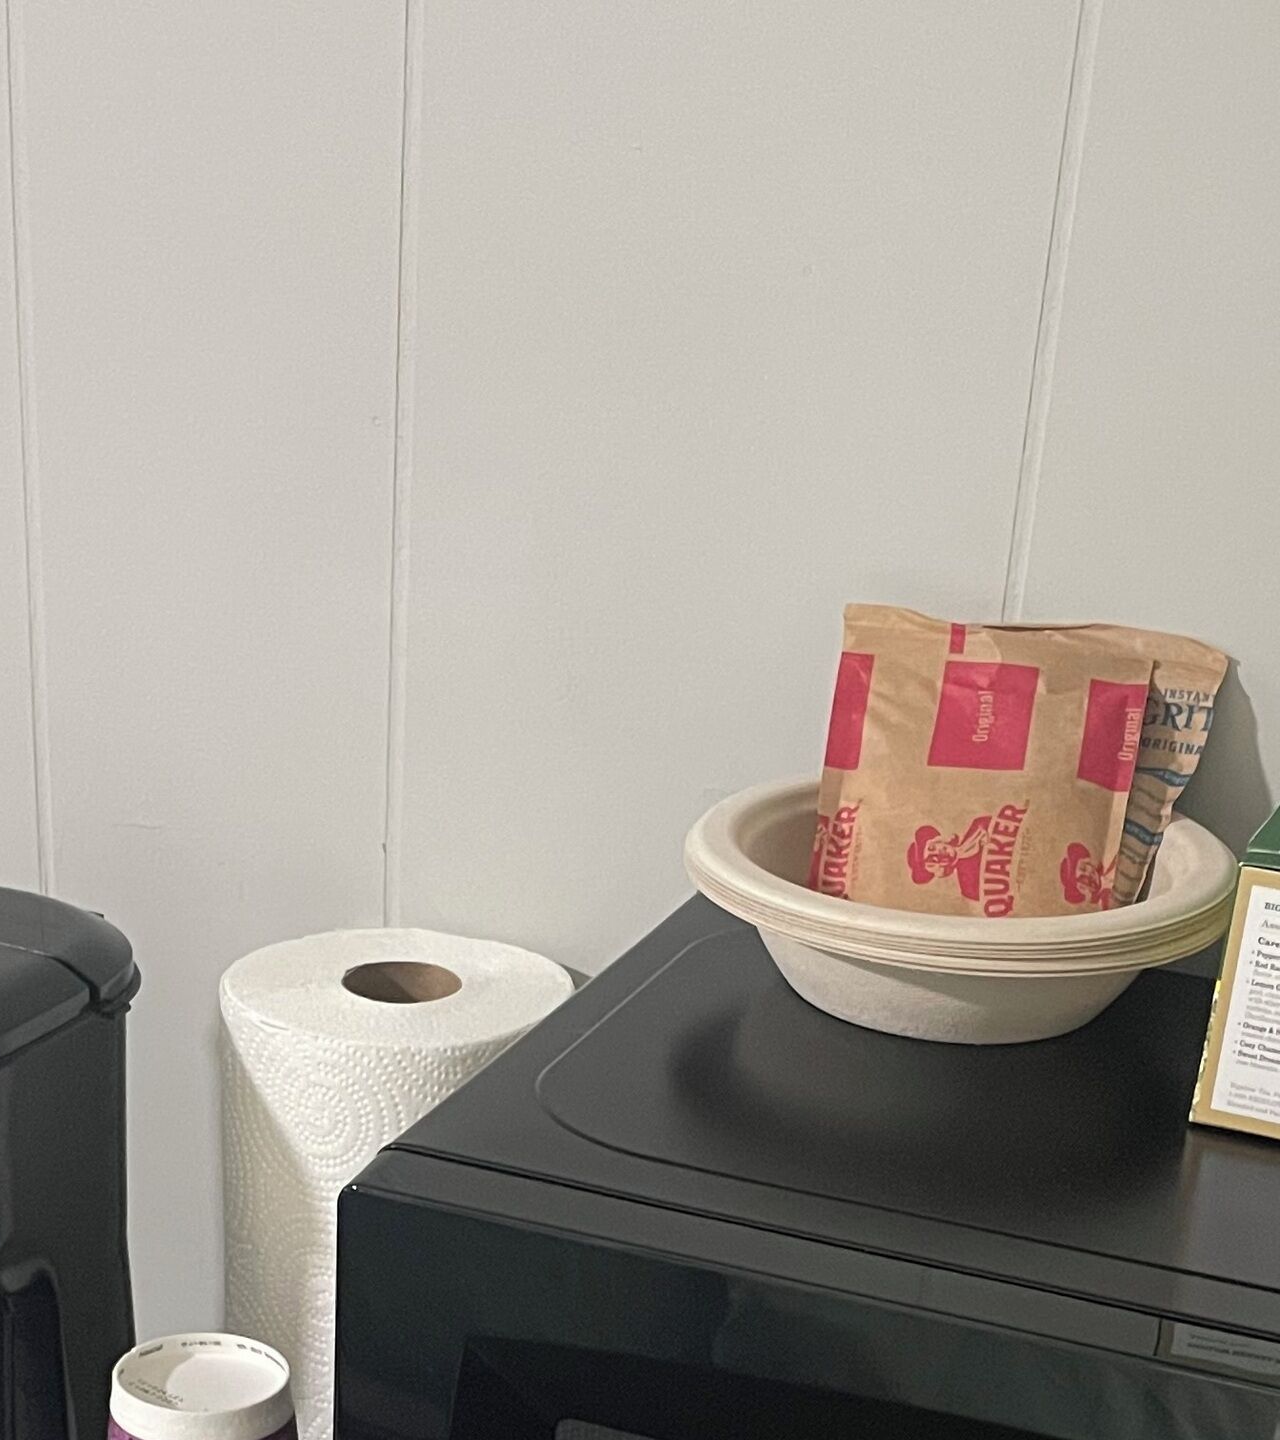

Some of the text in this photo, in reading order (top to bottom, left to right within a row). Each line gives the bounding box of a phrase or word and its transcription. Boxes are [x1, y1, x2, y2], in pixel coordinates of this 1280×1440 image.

[972, 690, 995, 742] Original
[1143, 698, 1215, 732] GRIT
[1164, 688, 1214, 703] INSTAN
[1117, 708, 1142, 761] Original
[1141, 737, 1203, 755] ORIGINA
[821, 805, 860, 899] UAKER
[983, 804, 1029, 918] QUAKER
